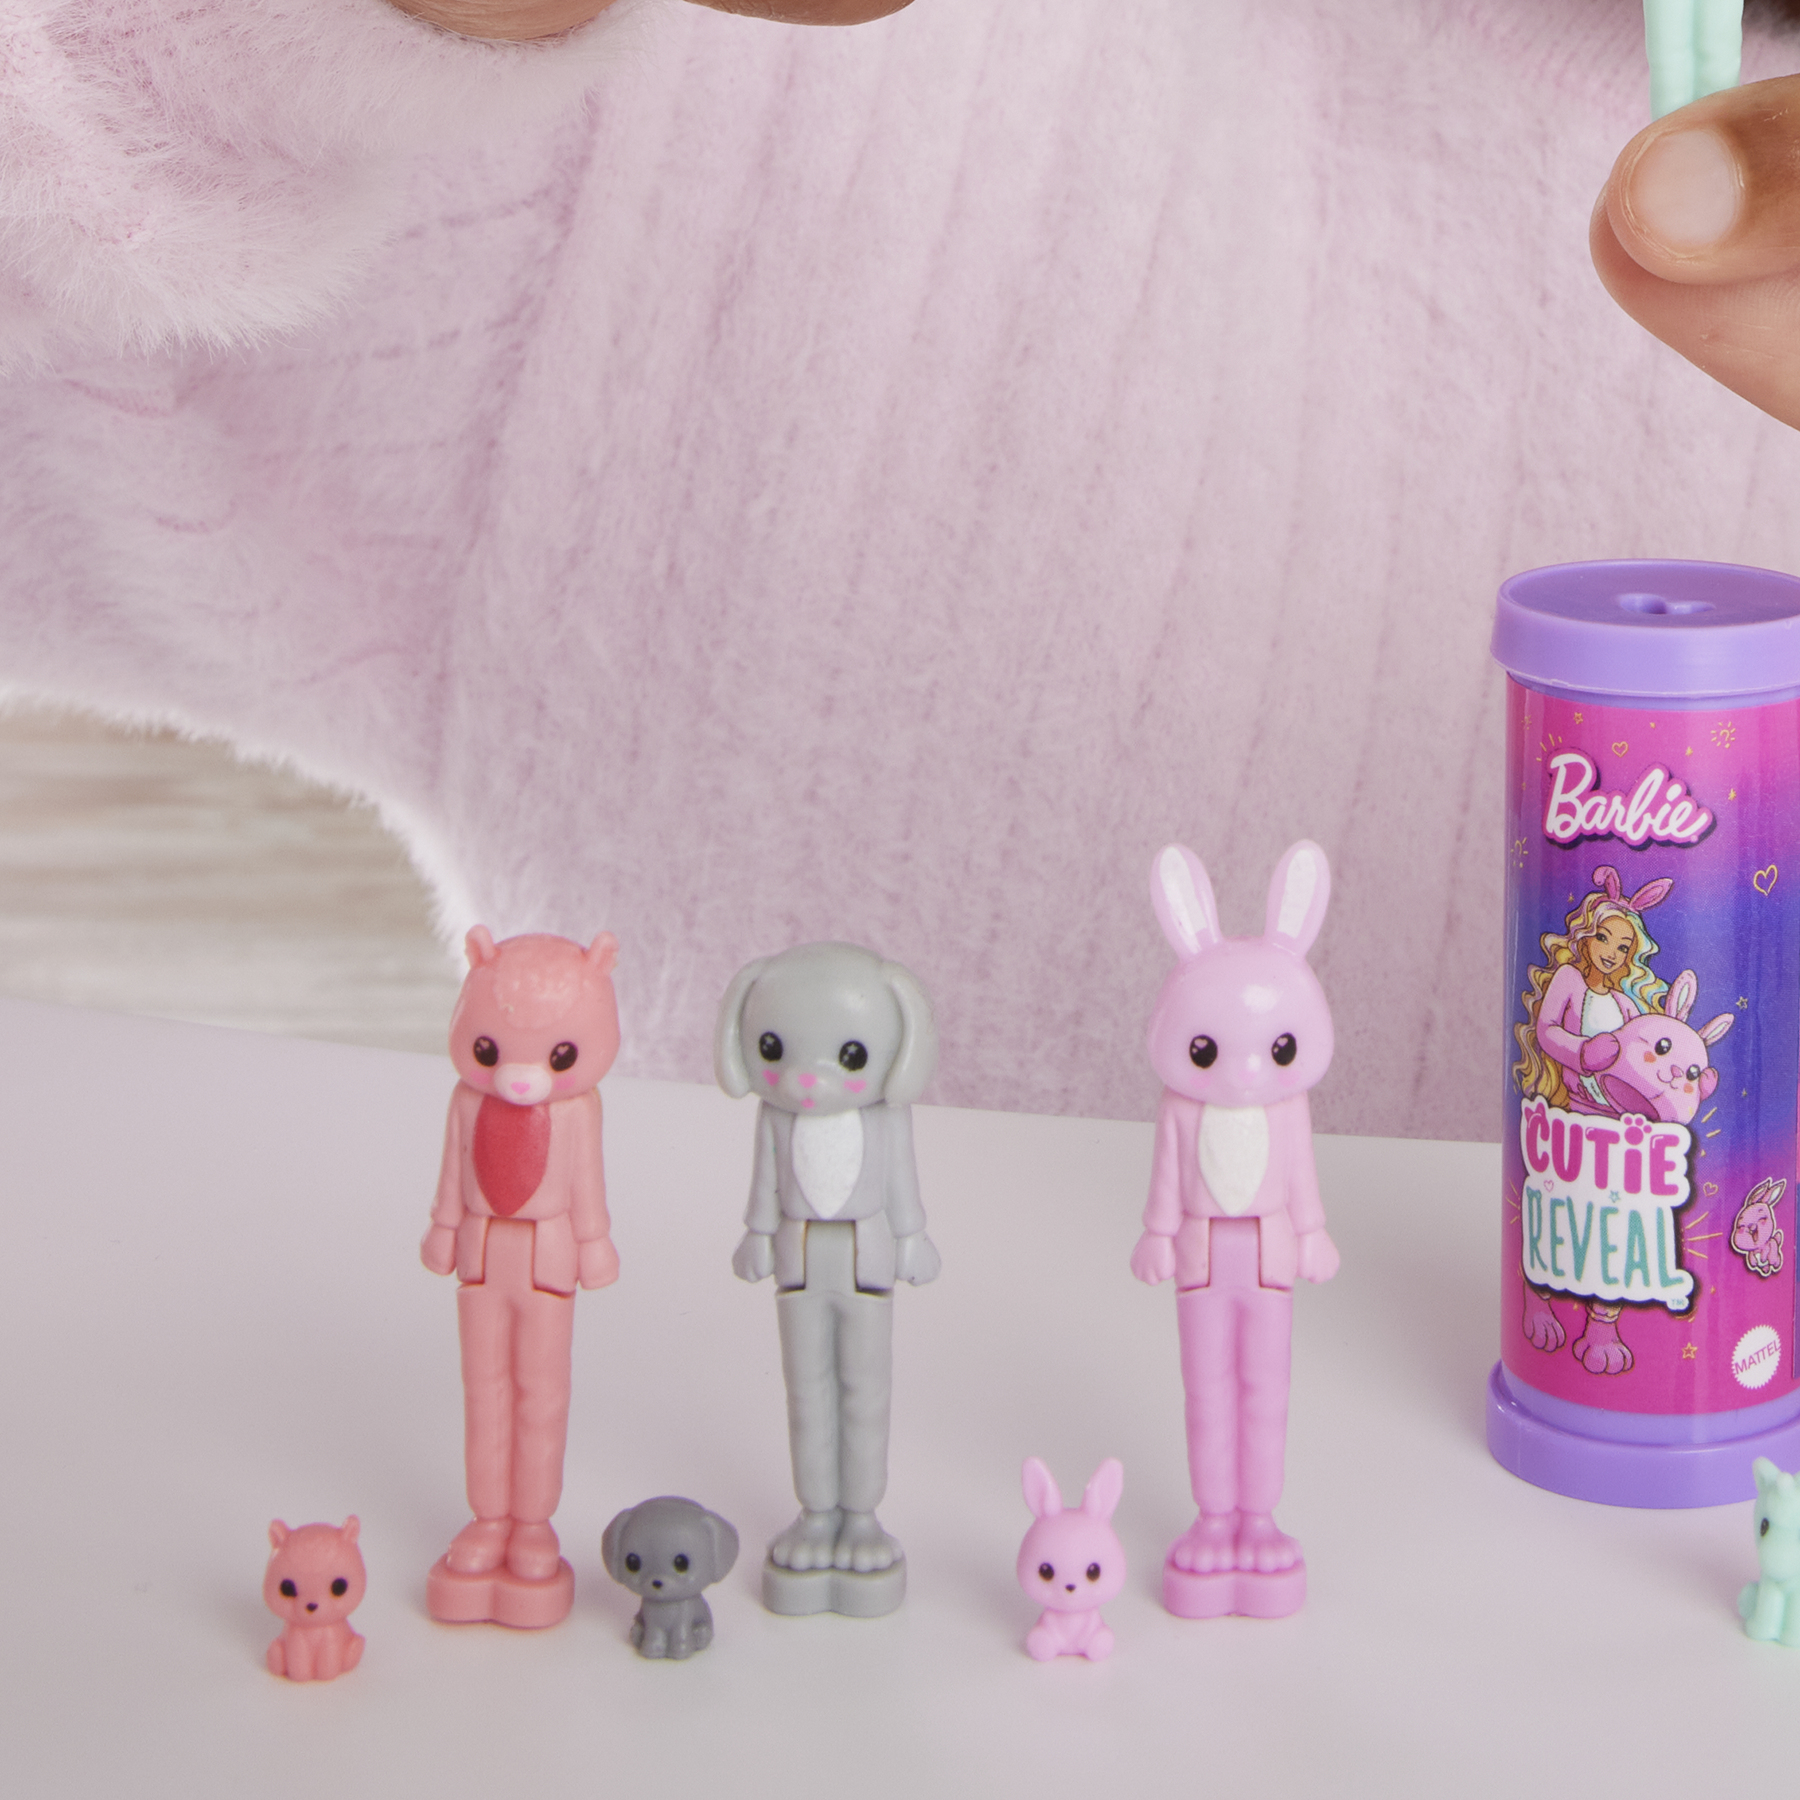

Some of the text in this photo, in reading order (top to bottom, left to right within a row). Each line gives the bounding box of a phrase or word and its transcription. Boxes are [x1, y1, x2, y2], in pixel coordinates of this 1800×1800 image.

[1545, 753, 1708, 841] Barbie
[1526, 1185, 1684, 1288] REVEAL
[1734, 1340, 1781, 1375] MATTEL
